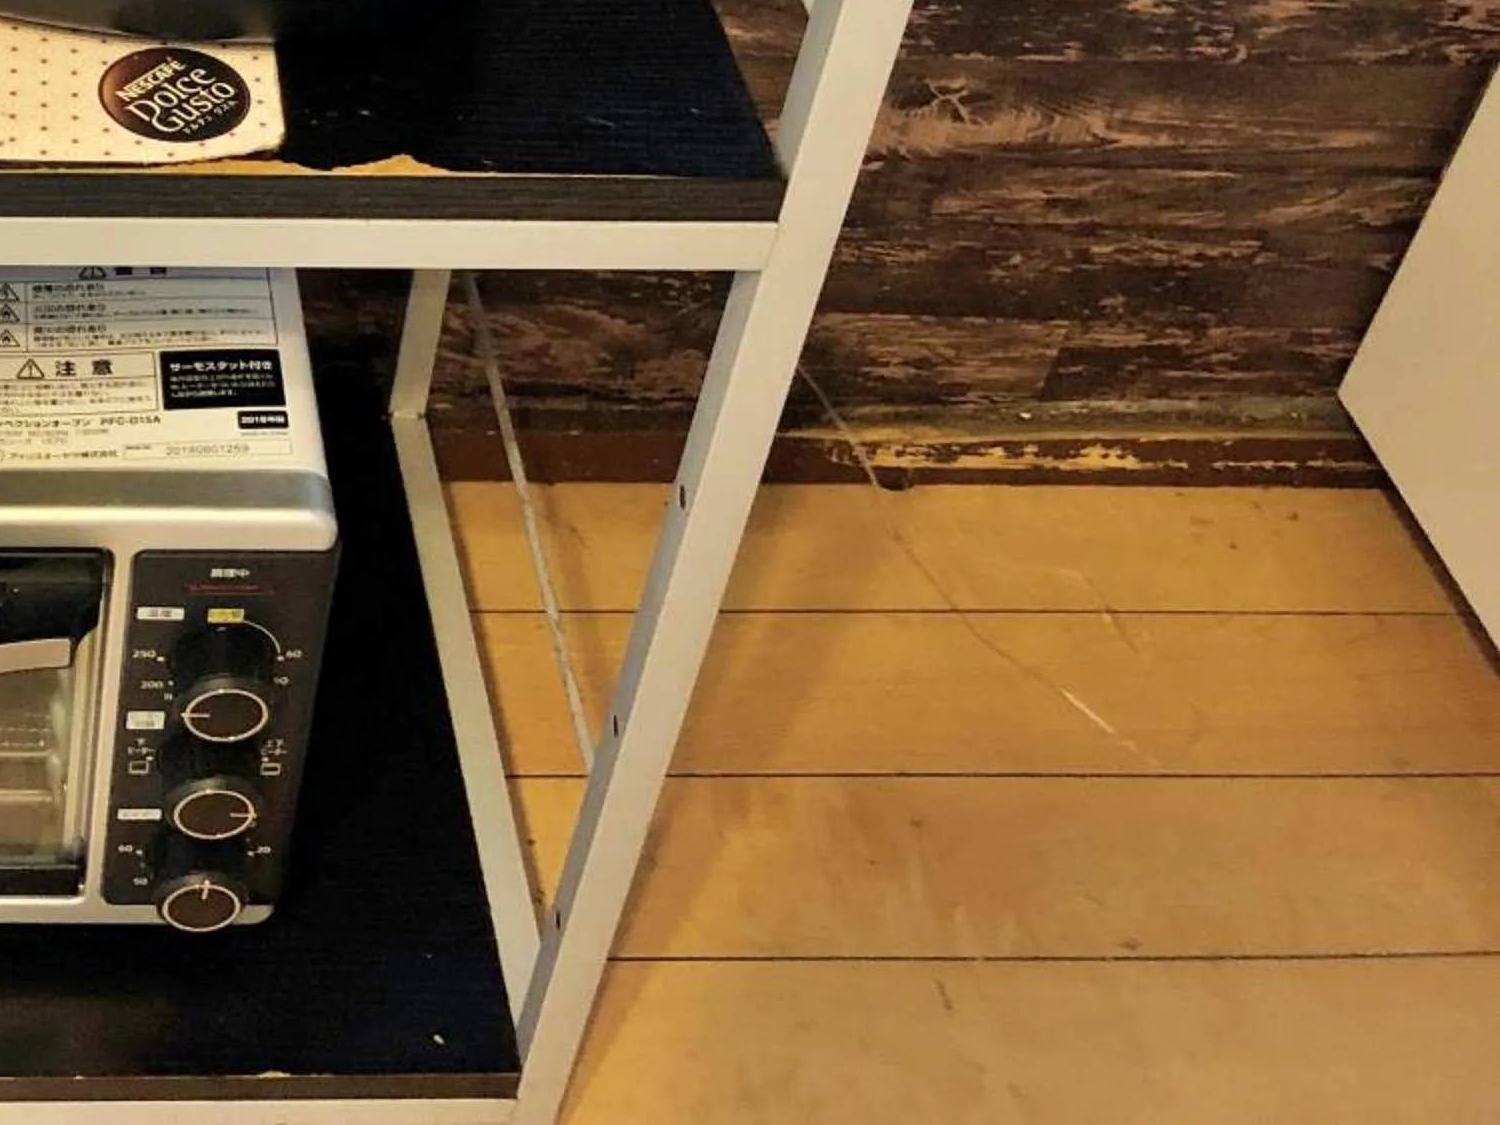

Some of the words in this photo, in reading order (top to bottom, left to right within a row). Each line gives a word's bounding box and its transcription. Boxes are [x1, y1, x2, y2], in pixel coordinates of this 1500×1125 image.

[115, 56, 188, 102] NESCAFÉ
[124, 68, 216, 122] Dolce
[150, 81, 236, 134] Gusto
[55, 359, 113, 377] 注意
[132, 649, 157, 659] 250
